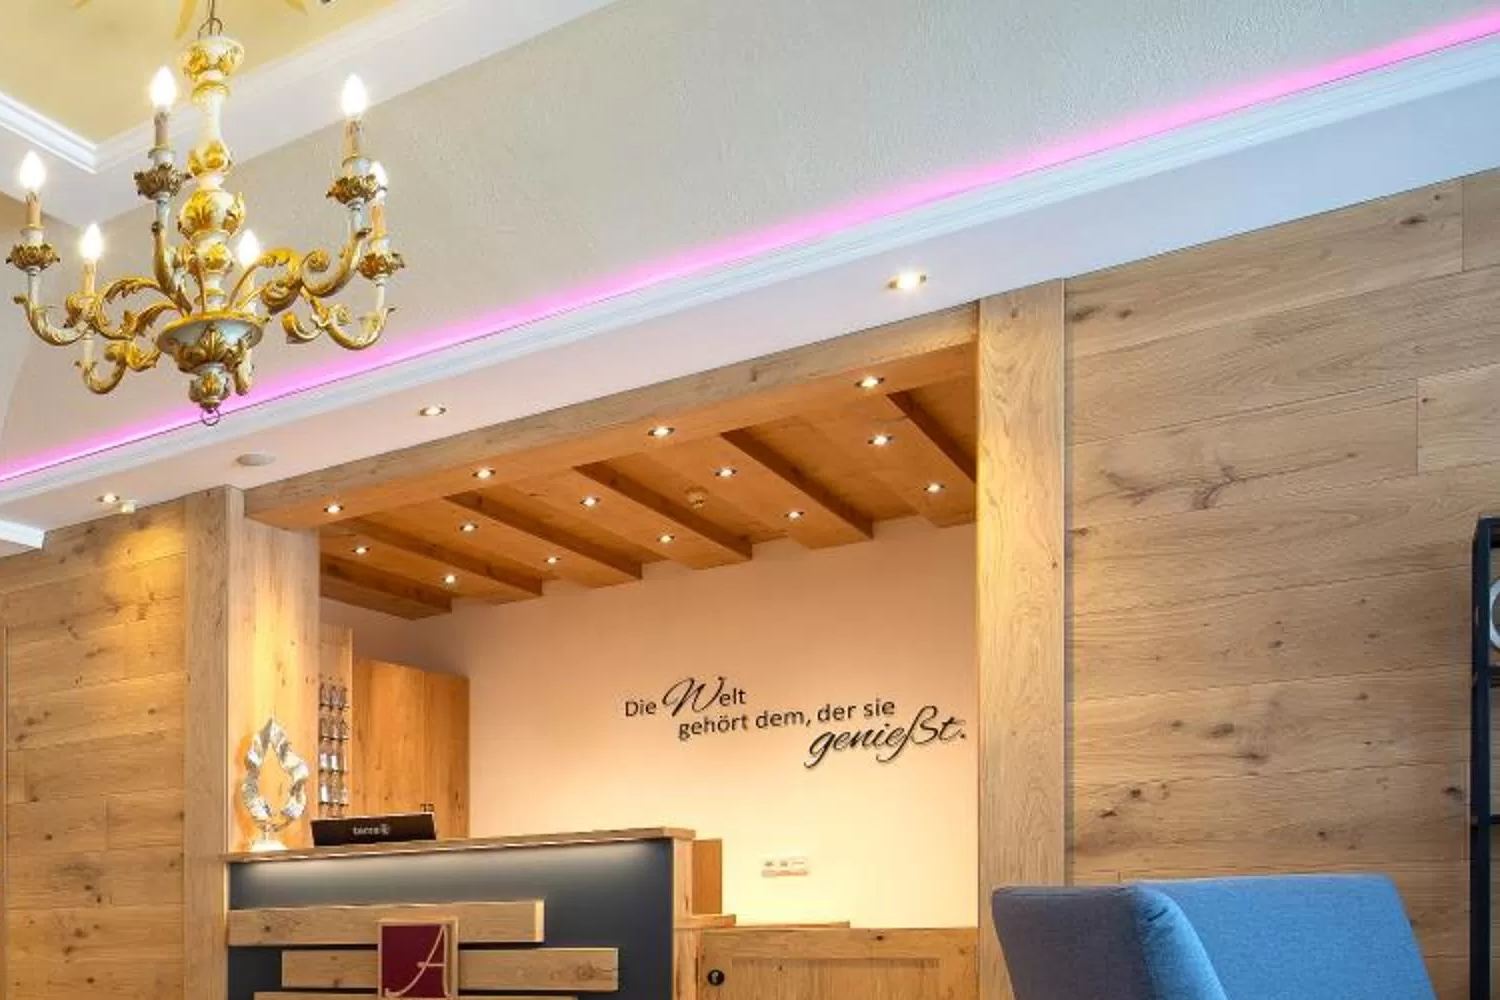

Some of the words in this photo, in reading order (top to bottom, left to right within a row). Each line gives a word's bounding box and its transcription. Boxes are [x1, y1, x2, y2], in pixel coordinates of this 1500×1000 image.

[624, 699, 657, 718] Die
[661, 675, 747, 717] Welt
[678, 713, 749, 741] gehört
[754, 708, 811, 731] dem,
[816, 701, 857, 723] der
[863, 697, 896, 718] sie
[804, 704, 967, 769] genießt.
